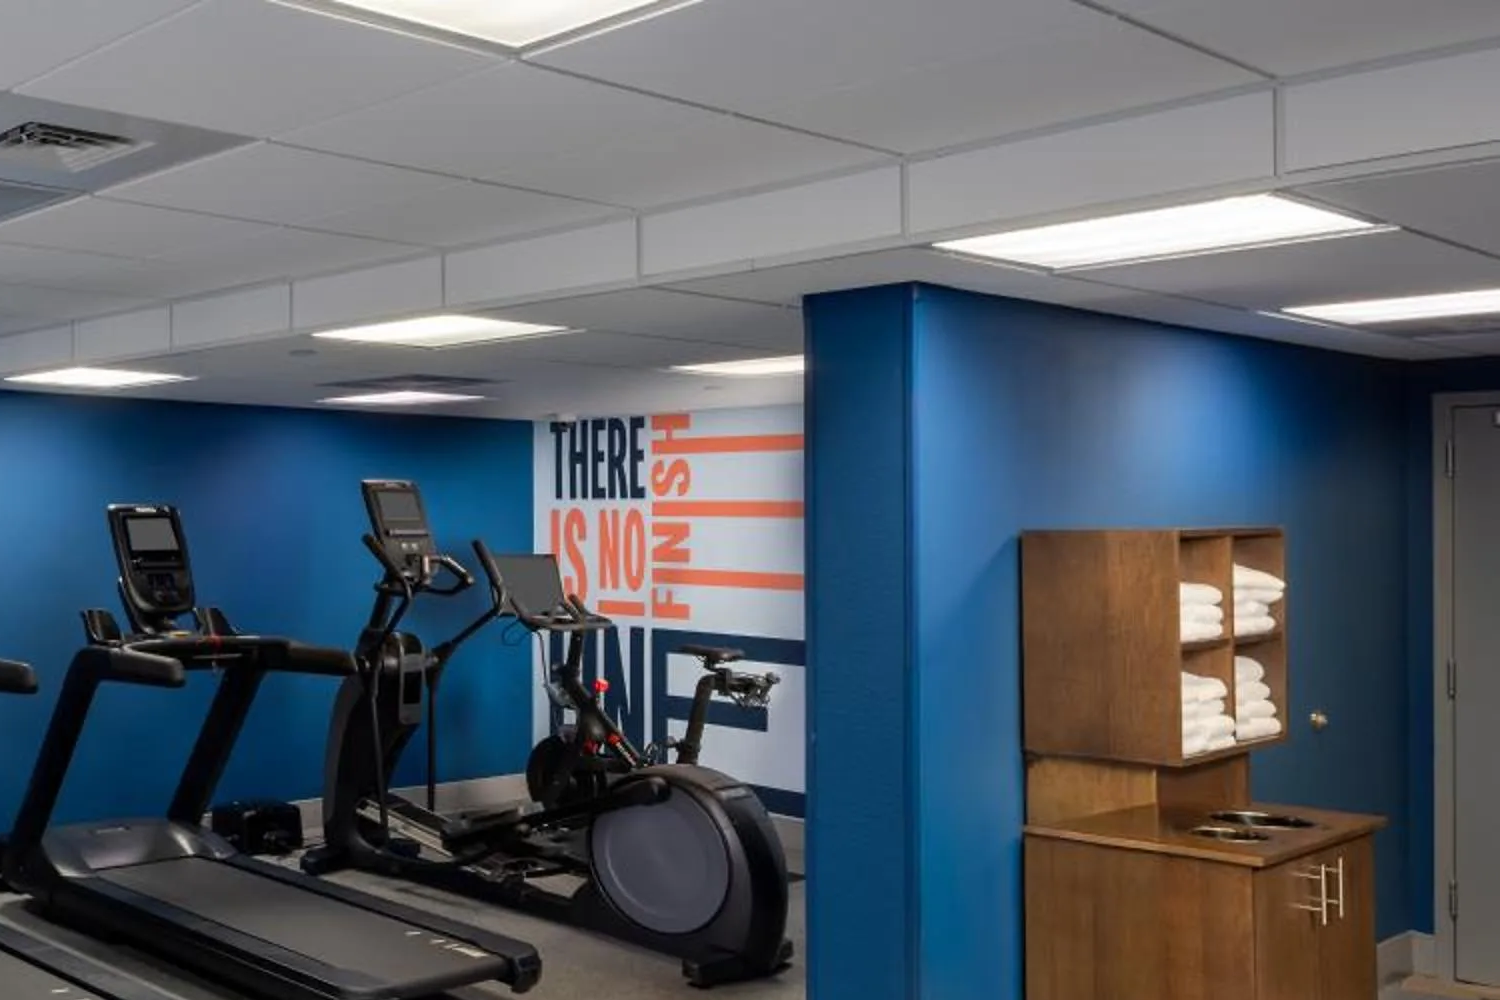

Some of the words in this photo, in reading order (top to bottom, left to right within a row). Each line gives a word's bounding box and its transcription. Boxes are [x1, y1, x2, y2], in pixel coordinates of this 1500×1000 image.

[550, 415, 646, 500] THERE
[599, 508, 646, 592] NO
[651, 413, 691, 621] FINISH
